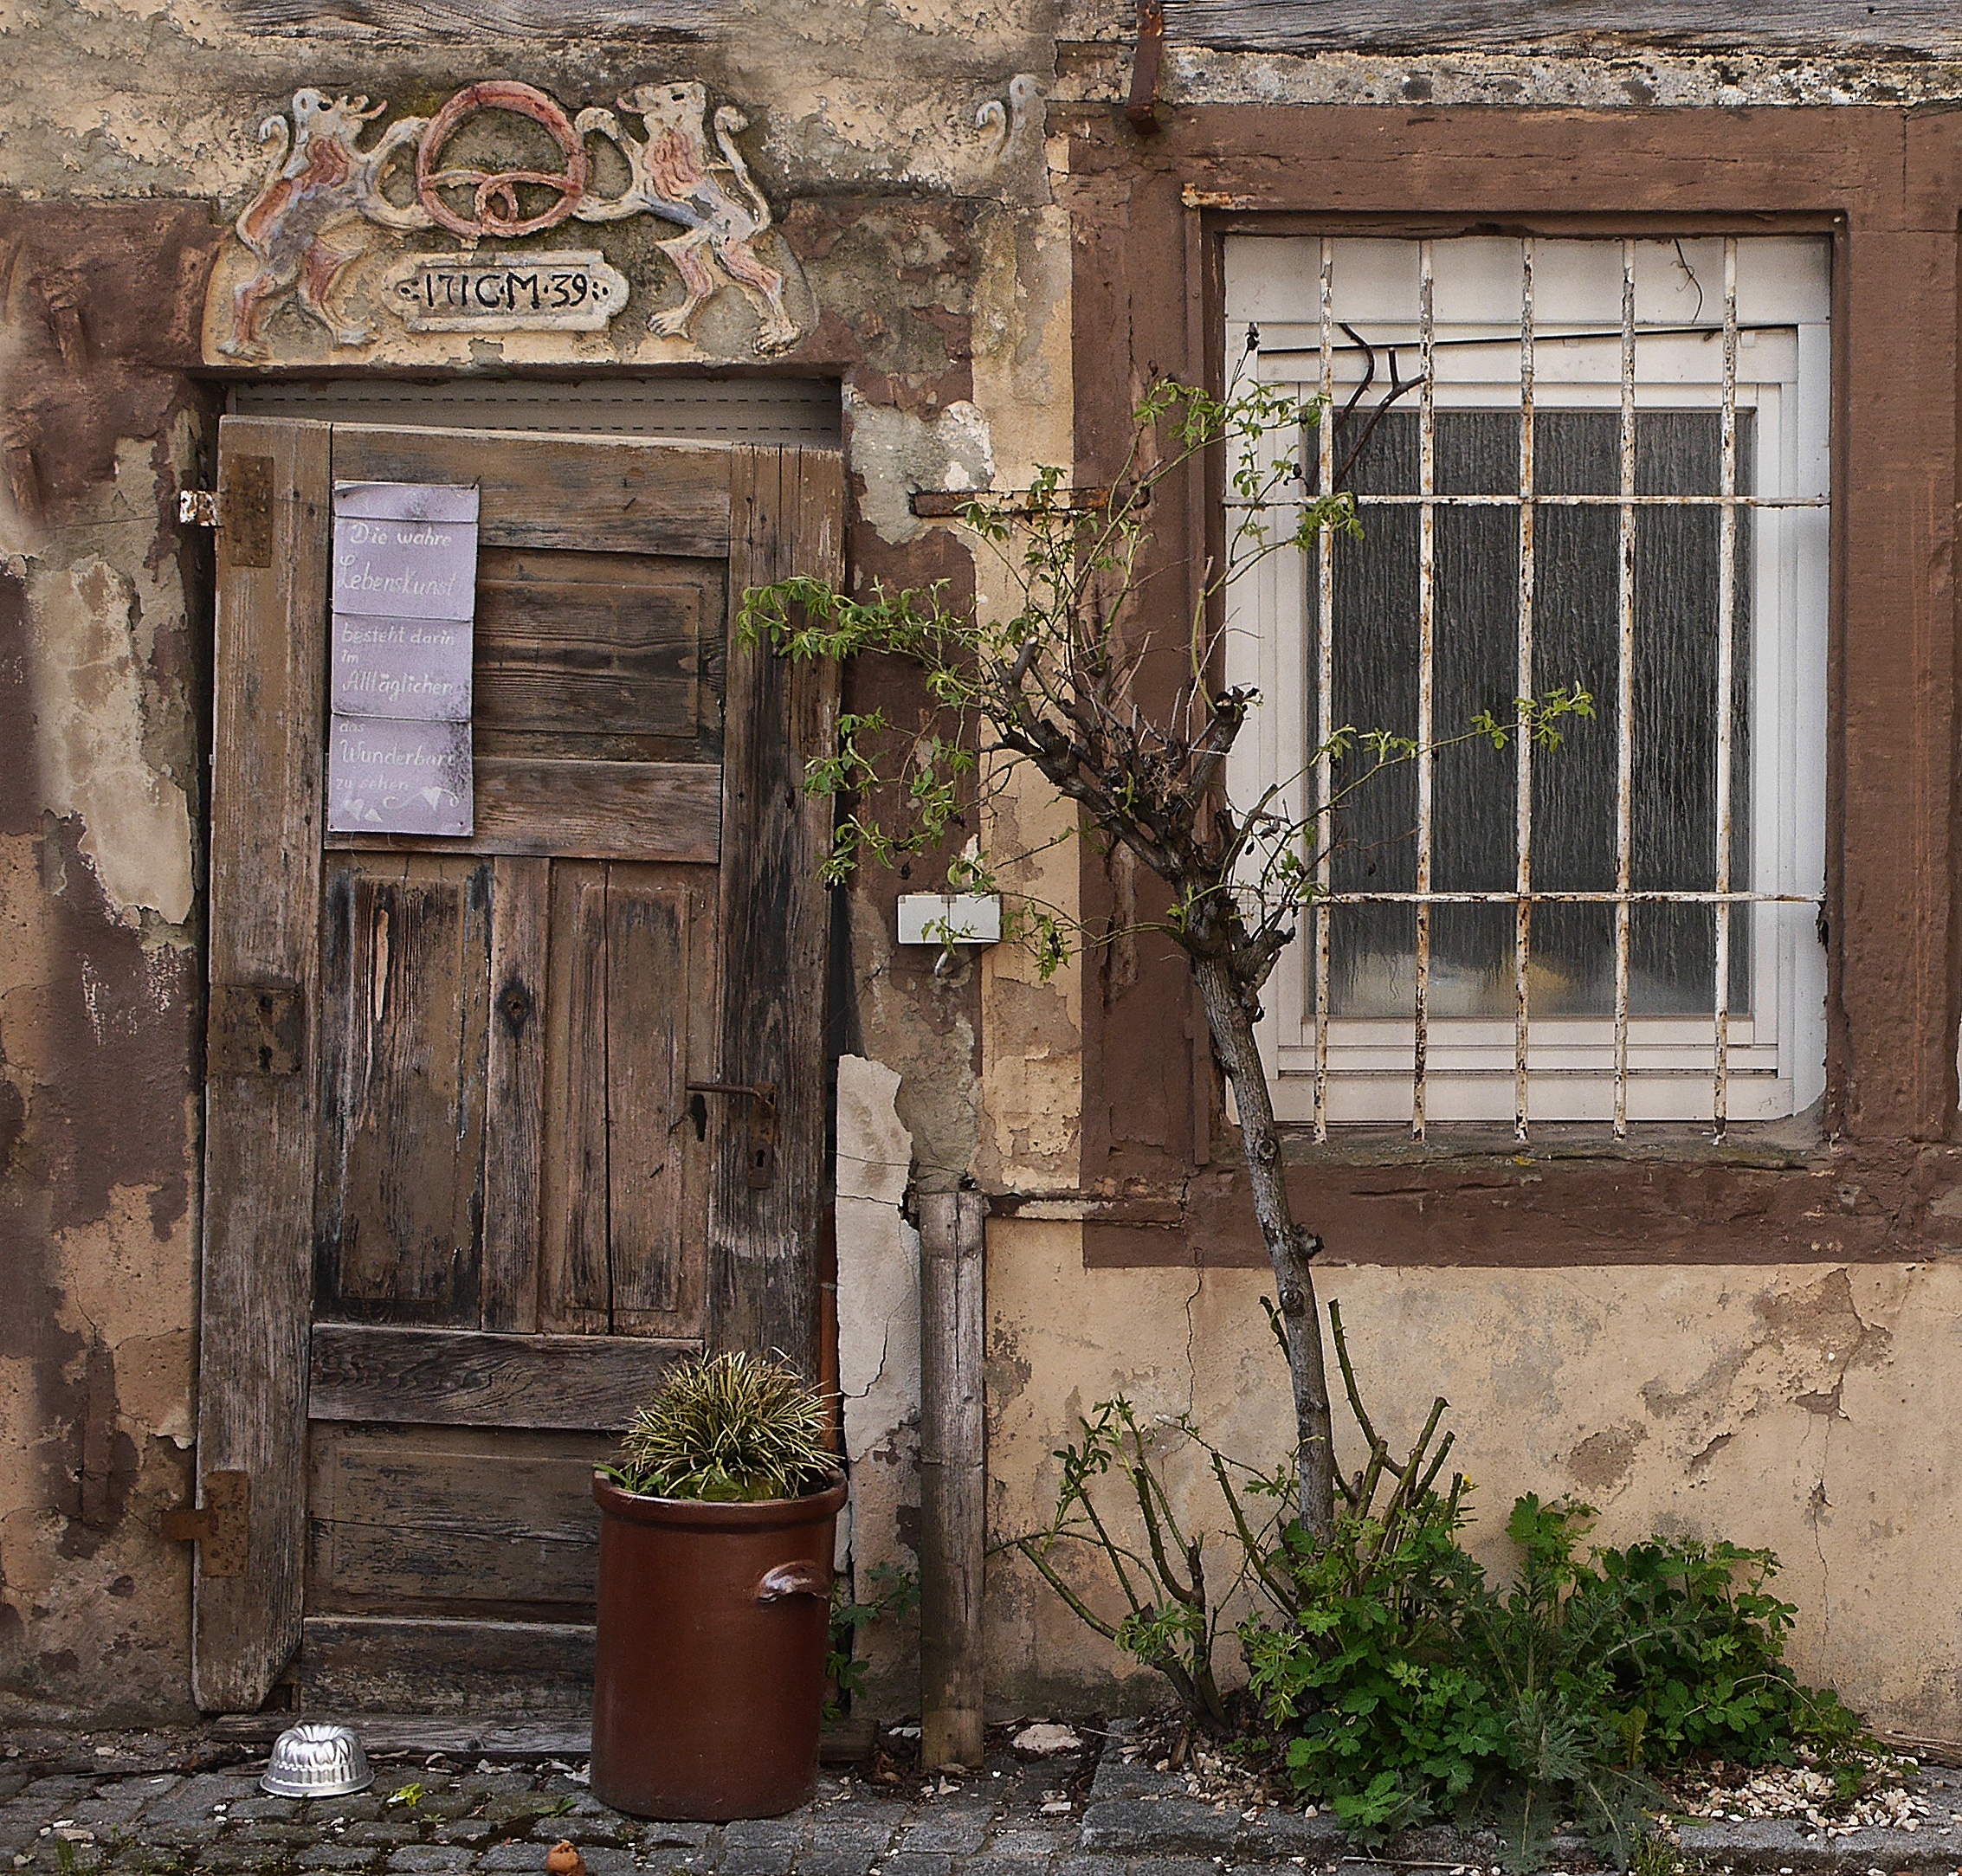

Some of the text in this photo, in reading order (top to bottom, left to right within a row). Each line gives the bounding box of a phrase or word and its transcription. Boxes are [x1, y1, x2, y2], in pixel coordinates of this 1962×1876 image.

[350, 522, 452, 547] Die wahre
[341, 621, 455, 646] besteht darin
[339, 720, 366, 733] das
[335, 773, 409, 791] zu sehen
